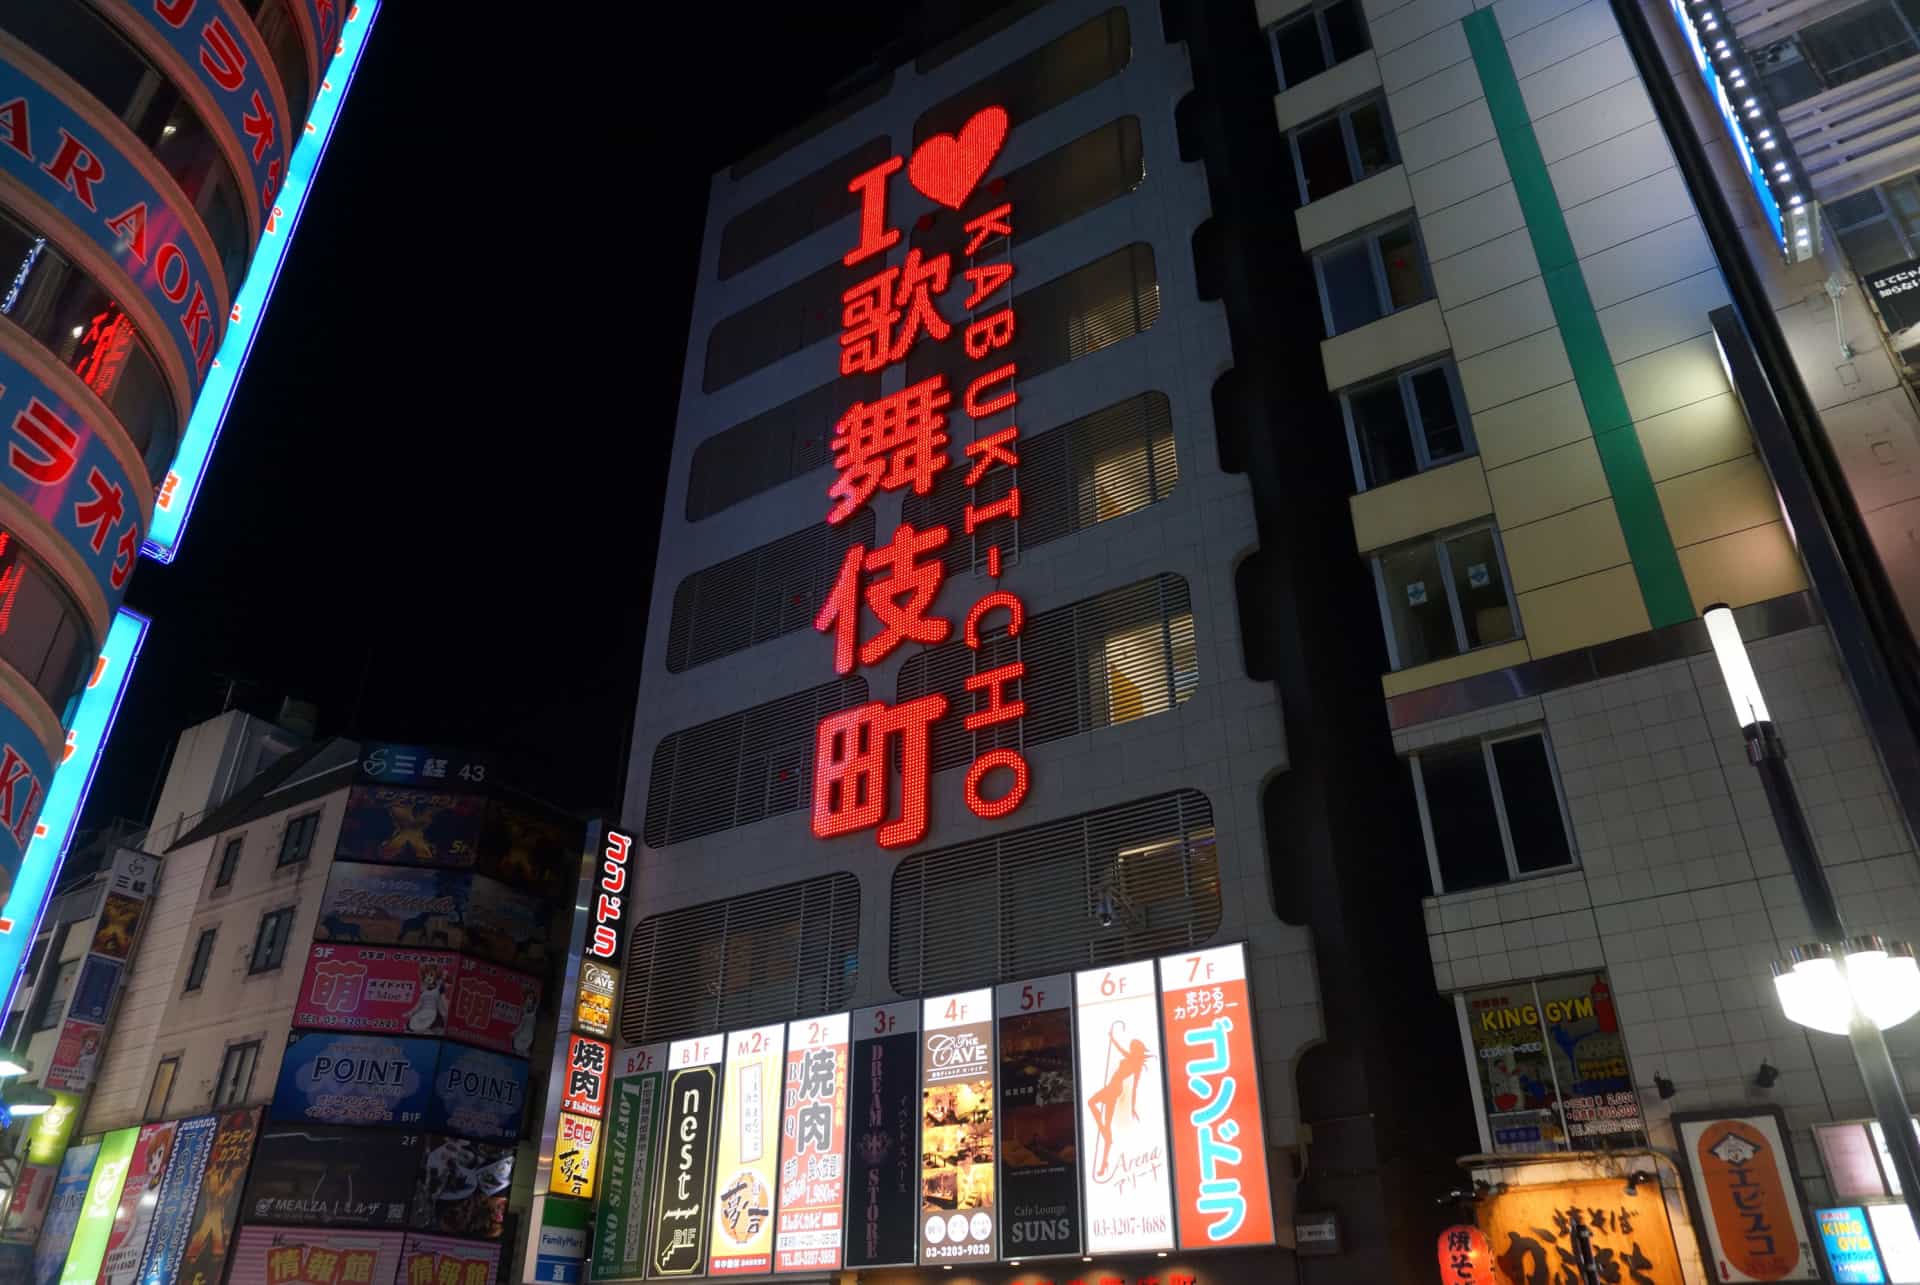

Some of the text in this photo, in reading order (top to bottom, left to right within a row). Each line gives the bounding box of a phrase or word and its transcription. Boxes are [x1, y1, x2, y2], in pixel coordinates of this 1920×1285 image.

[963, 202, 1031, 820] KABUKI-CHO
[811, 248, 951, 849] 歌舞伎町
[457, 763, 486, 782] 43
[314, 947, 334, 959] 3F
[1185, 956, 1215, 982] 7F
[1100, 972, 1127, 996] 6F
[1020, 985, 1046, 1010] 5F
[1185, 987, 1224, 1008] まわる
[873, 1010, 896, 1034] 3F
[943, 999, 968, 1022] 4F
[1174, 1001, 1240, 1021] カウンター
[1481, 997, 1594, 1031] KING GYM
[738, 1032, 770, 1056] M2F
[808, 1022, 828, 1044] 2F
[626, 1050, 654, 1073] B2F
[682, 1042, 709, 1064] B1F
[928, 1034, 988, 1067] CAVE
[311, 1056, 410, 1087] POINT
[569, 1039, 606, 1102] 焼肉
[448, 1068, 519, 1105] POINT
[797, 1049, 837, 1154] 焼肉
[401, 1112, 422, 1122] B1F
[1184, 1016, 1247, 1241] ゴンドラ
[401, 1136, 418, 1146] 2F
[678, 1088, 700, 1201] nest
[865, 1044, 884, 1259] DREAM STORE
[1113, 1146, 1163, 1174] Arena
[274, 1199, 328, 1213] MEALZA
[1034, 1203, 1066, 1217] Lounge
[542, 1233, 585, 1249] FamilyMart
[673, 1228, 697, 1245] B1F
[1012, 1218, 1071, 1244] SUNS
[926, 1245, 990, 1258] 03-3203-9020
